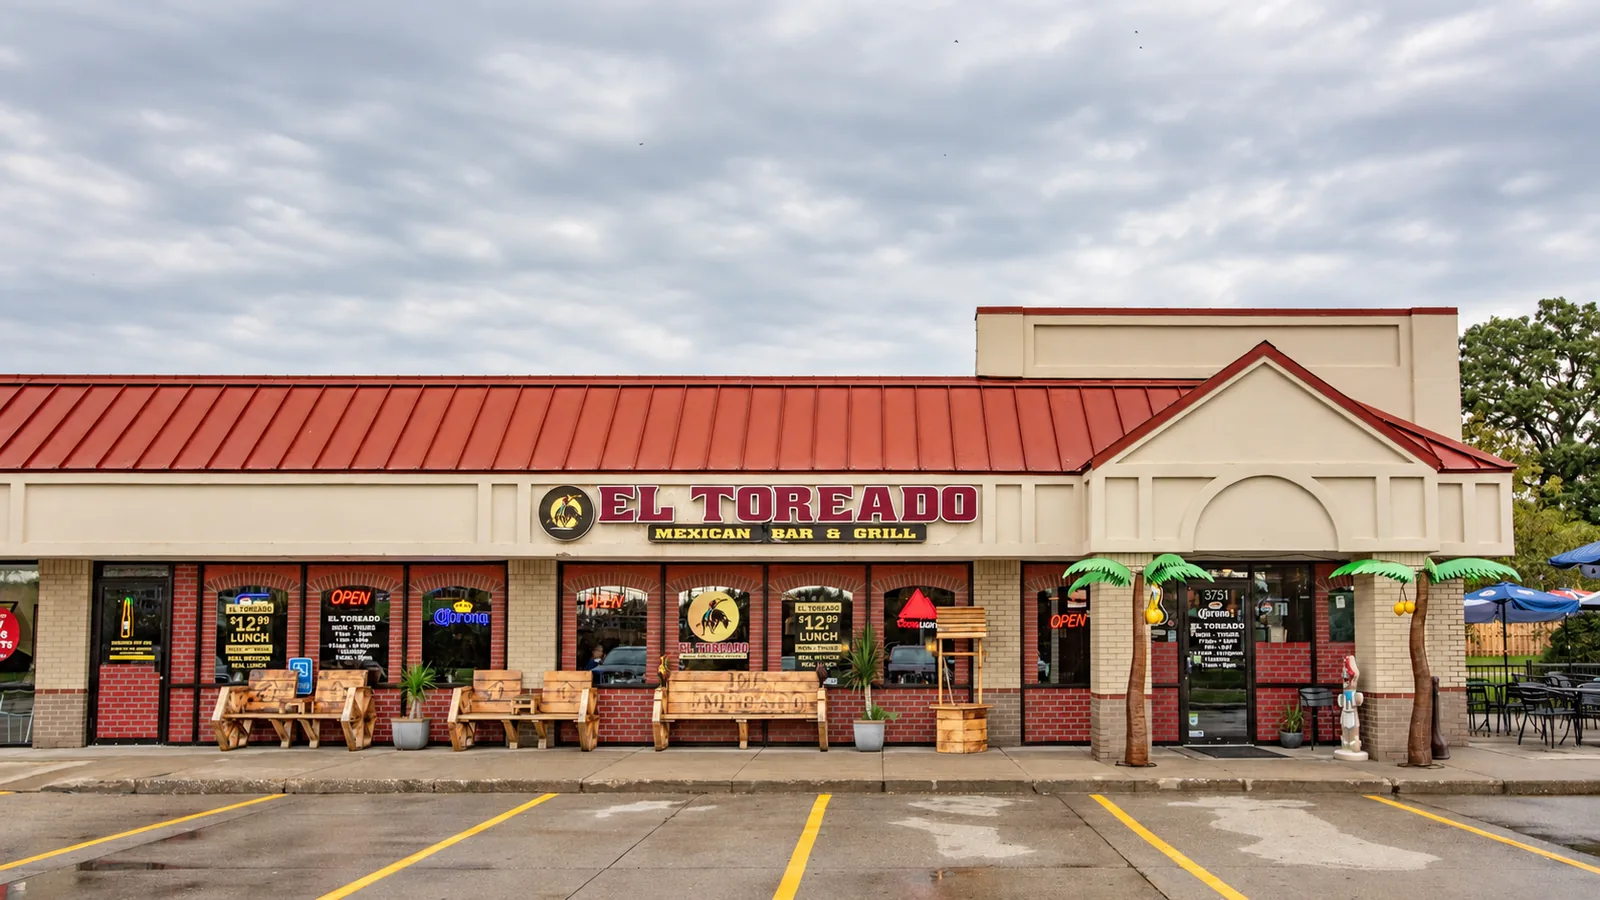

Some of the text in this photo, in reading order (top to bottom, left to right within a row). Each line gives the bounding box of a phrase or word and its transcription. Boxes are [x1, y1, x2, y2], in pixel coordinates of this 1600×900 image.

[597, 485, 981, 523] EL TOREADO
[654, 528, 917, 540] MEXICAN BAR & GRILL
[331, 589, 371, 605] OPEN
[1204, 590, 1229, 600] 3751
[434, 608, 489, 627] Corona
[1197, 608, 1230, 620] Corona
[1050, 613, 1087, 629] OPEN
[230, 633, 269, 643] LUNCH
[799, 632, 838, 642] LUNCH
[679, 642, 749, 654] EL TOREADO
